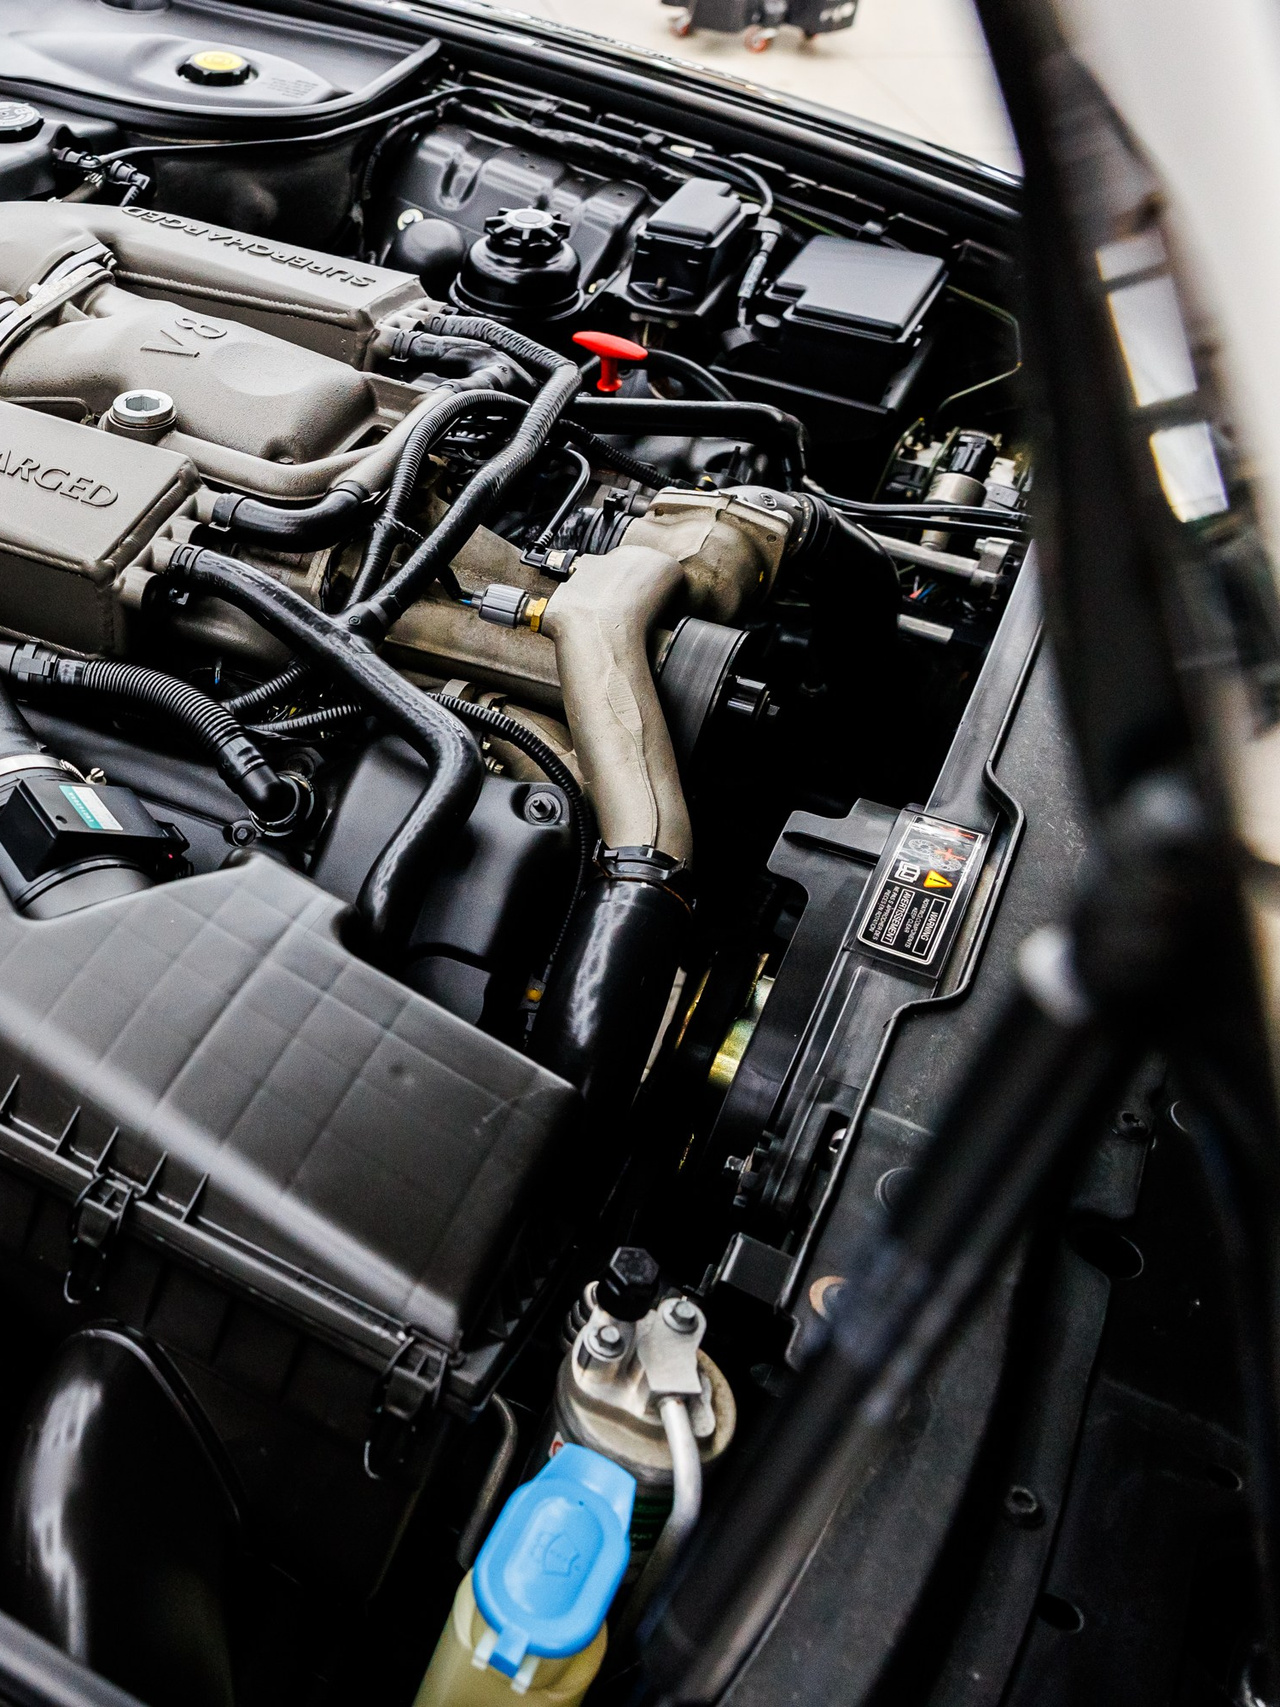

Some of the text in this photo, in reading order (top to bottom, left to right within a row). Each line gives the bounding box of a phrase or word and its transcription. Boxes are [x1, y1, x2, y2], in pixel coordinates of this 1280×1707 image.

[121, 206, 376, 288] SUPERCHARGED
[140, 316, 228, 358] V8
[868, 910, 882, 932] ROTATION
[883, 891, 912, 942] AVERTISSEMENT
[903, 906, 917, 933] KEEP CLEAR
[904, 897, 930, 948] ROTATING COMPONENTS
[919, 910, 938, 941] WARNING
